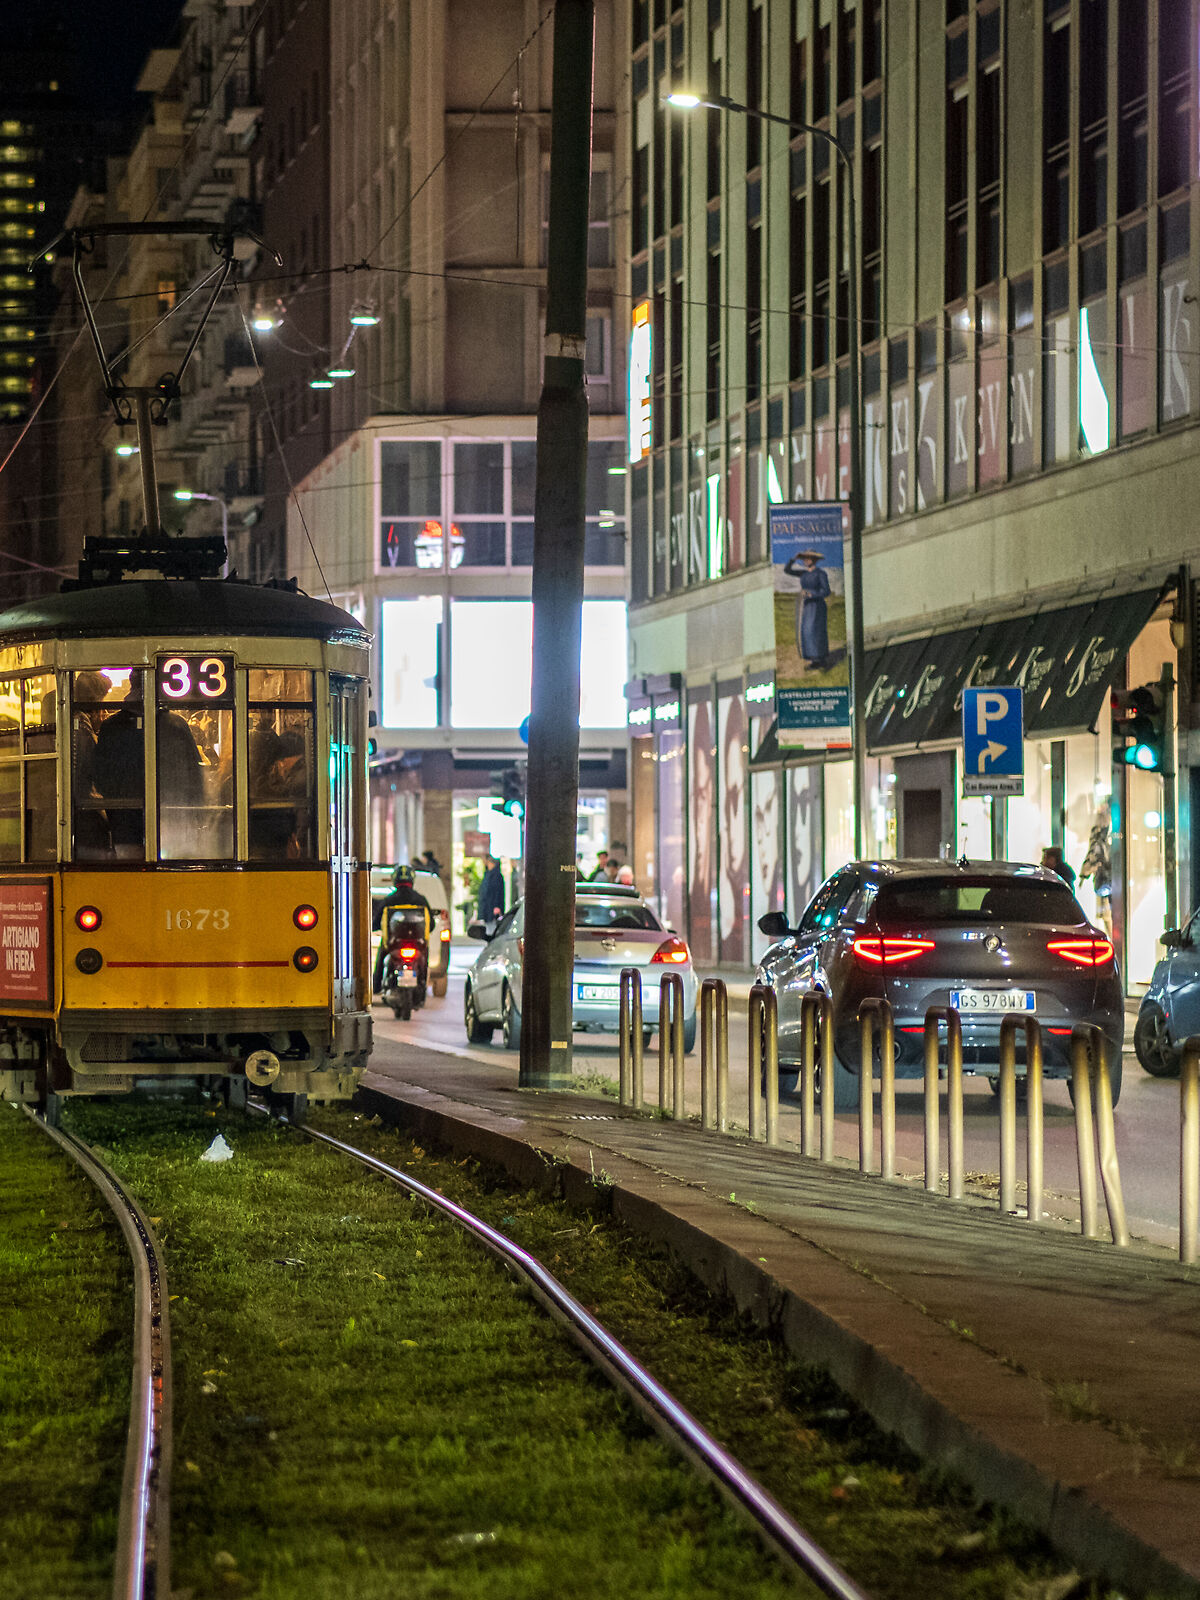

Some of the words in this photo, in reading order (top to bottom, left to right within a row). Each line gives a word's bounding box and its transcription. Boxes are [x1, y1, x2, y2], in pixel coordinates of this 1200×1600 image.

[162, 658, 228, 698] 33
[977, 693, 1009, 735] P
[165, 909, 230, 931] 1673
[2, 926, 40, 949] ARTIGIANO
[6, 949, 15, 971] IN
[15, 950, 35, 972] FIERA
[960, 993, 978, 1008] GS
